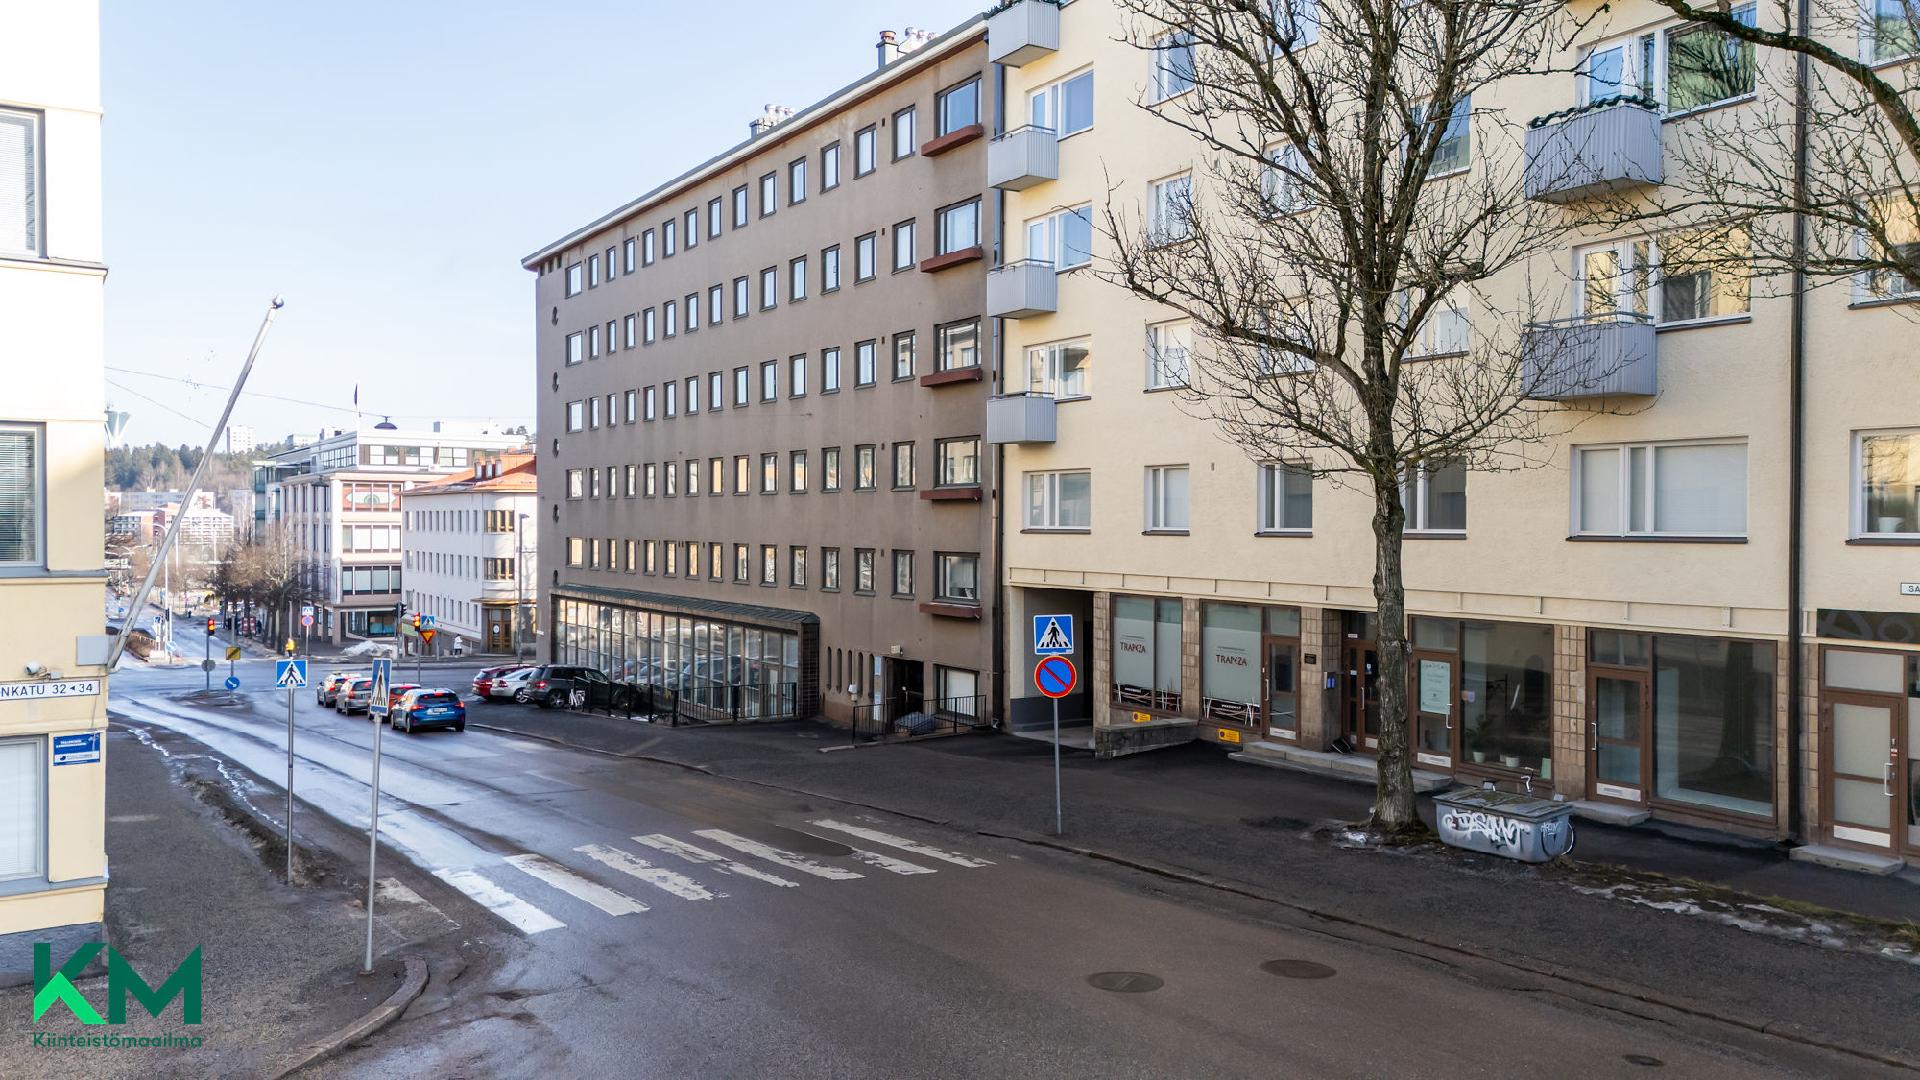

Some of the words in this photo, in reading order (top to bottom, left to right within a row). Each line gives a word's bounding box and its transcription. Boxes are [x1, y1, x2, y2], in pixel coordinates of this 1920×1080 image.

[1, 685, 45, 697] NKATU
[52, 684, 67, 694] 32
[79, 683, 93, 693] 34
